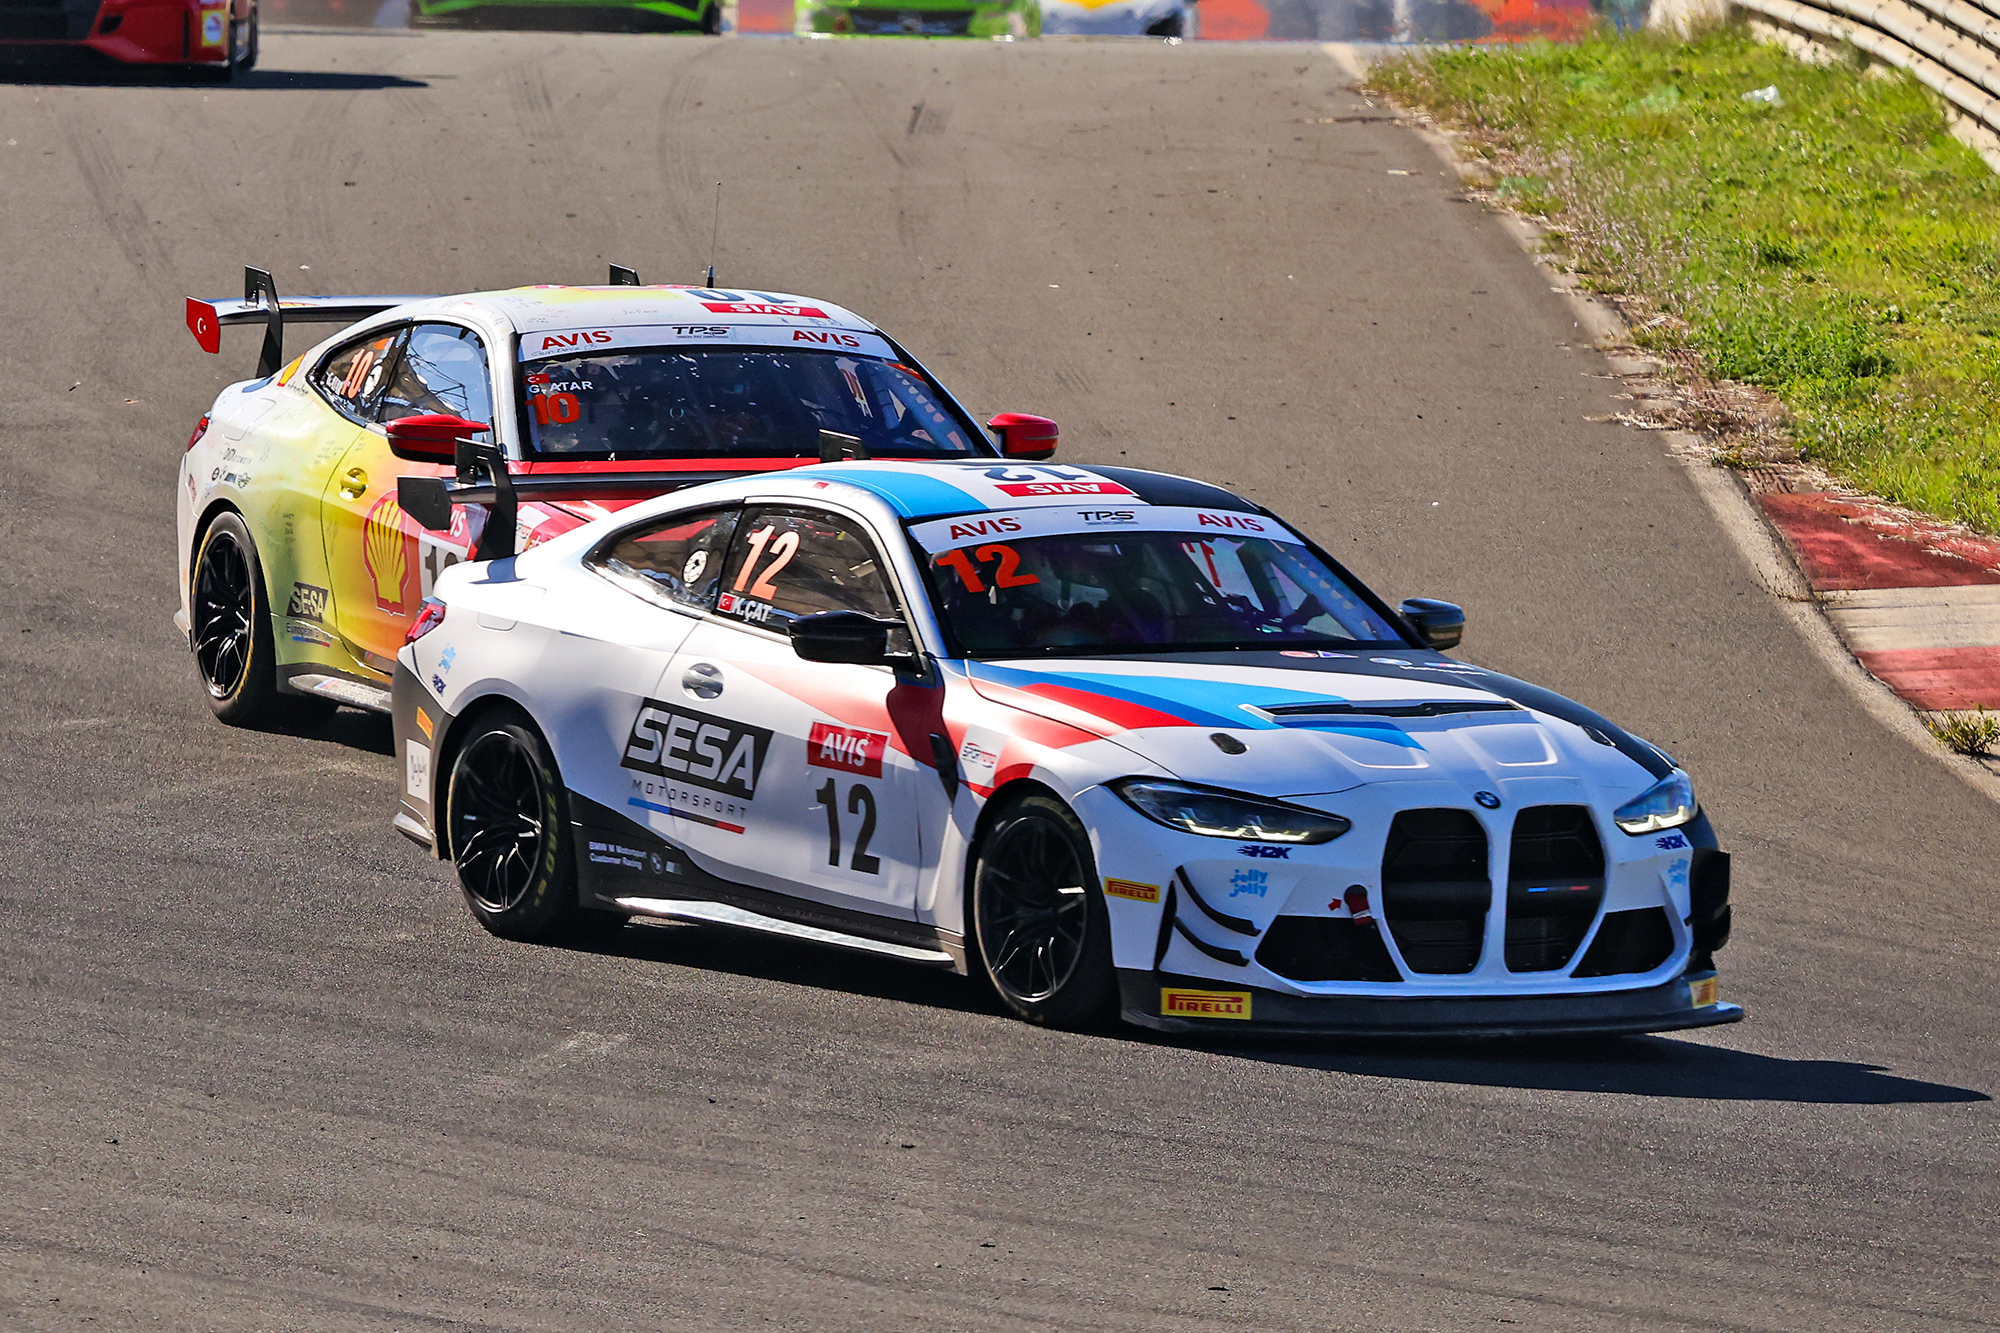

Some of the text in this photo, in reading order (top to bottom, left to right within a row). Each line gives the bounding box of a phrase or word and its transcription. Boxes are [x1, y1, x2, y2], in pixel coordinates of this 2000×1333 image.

[730, 303, 801, 315] AVIS
[542, 331, 612, 350] AVIS
[672, 326, 730, 336] TPS
[792, 330, 861, 348] AVIS
[341, 349, 375, 399] 10
[524, 392, 580, 425] 10
[961, 465, 1089, 482] 12
[1025, 484, 1102, 494] AVIS
[1077, 510, 1135, 521] TPS
[1197, 513, 1265, 532] AVIS
[950, 517, 1022, 541] AVIS
[732, 525, 800, 601] 12
[935, 544, 1040, 594] 12
[290, 585, 325, 619] SESA
[627, 706, 755, 791] SESA
[820, 732, 870, 767] AVIS
[631, 779, 747, 819] MOTORSPORT
[816, 777, 880, 876] 12
[1230, 868, 1268, 885] jolly
[1107, 880, 1156, 901] PIRELLI
[1229, 882, 1268, 898] jolly
[1167, 993, 1245, 1014] PIRELLI
